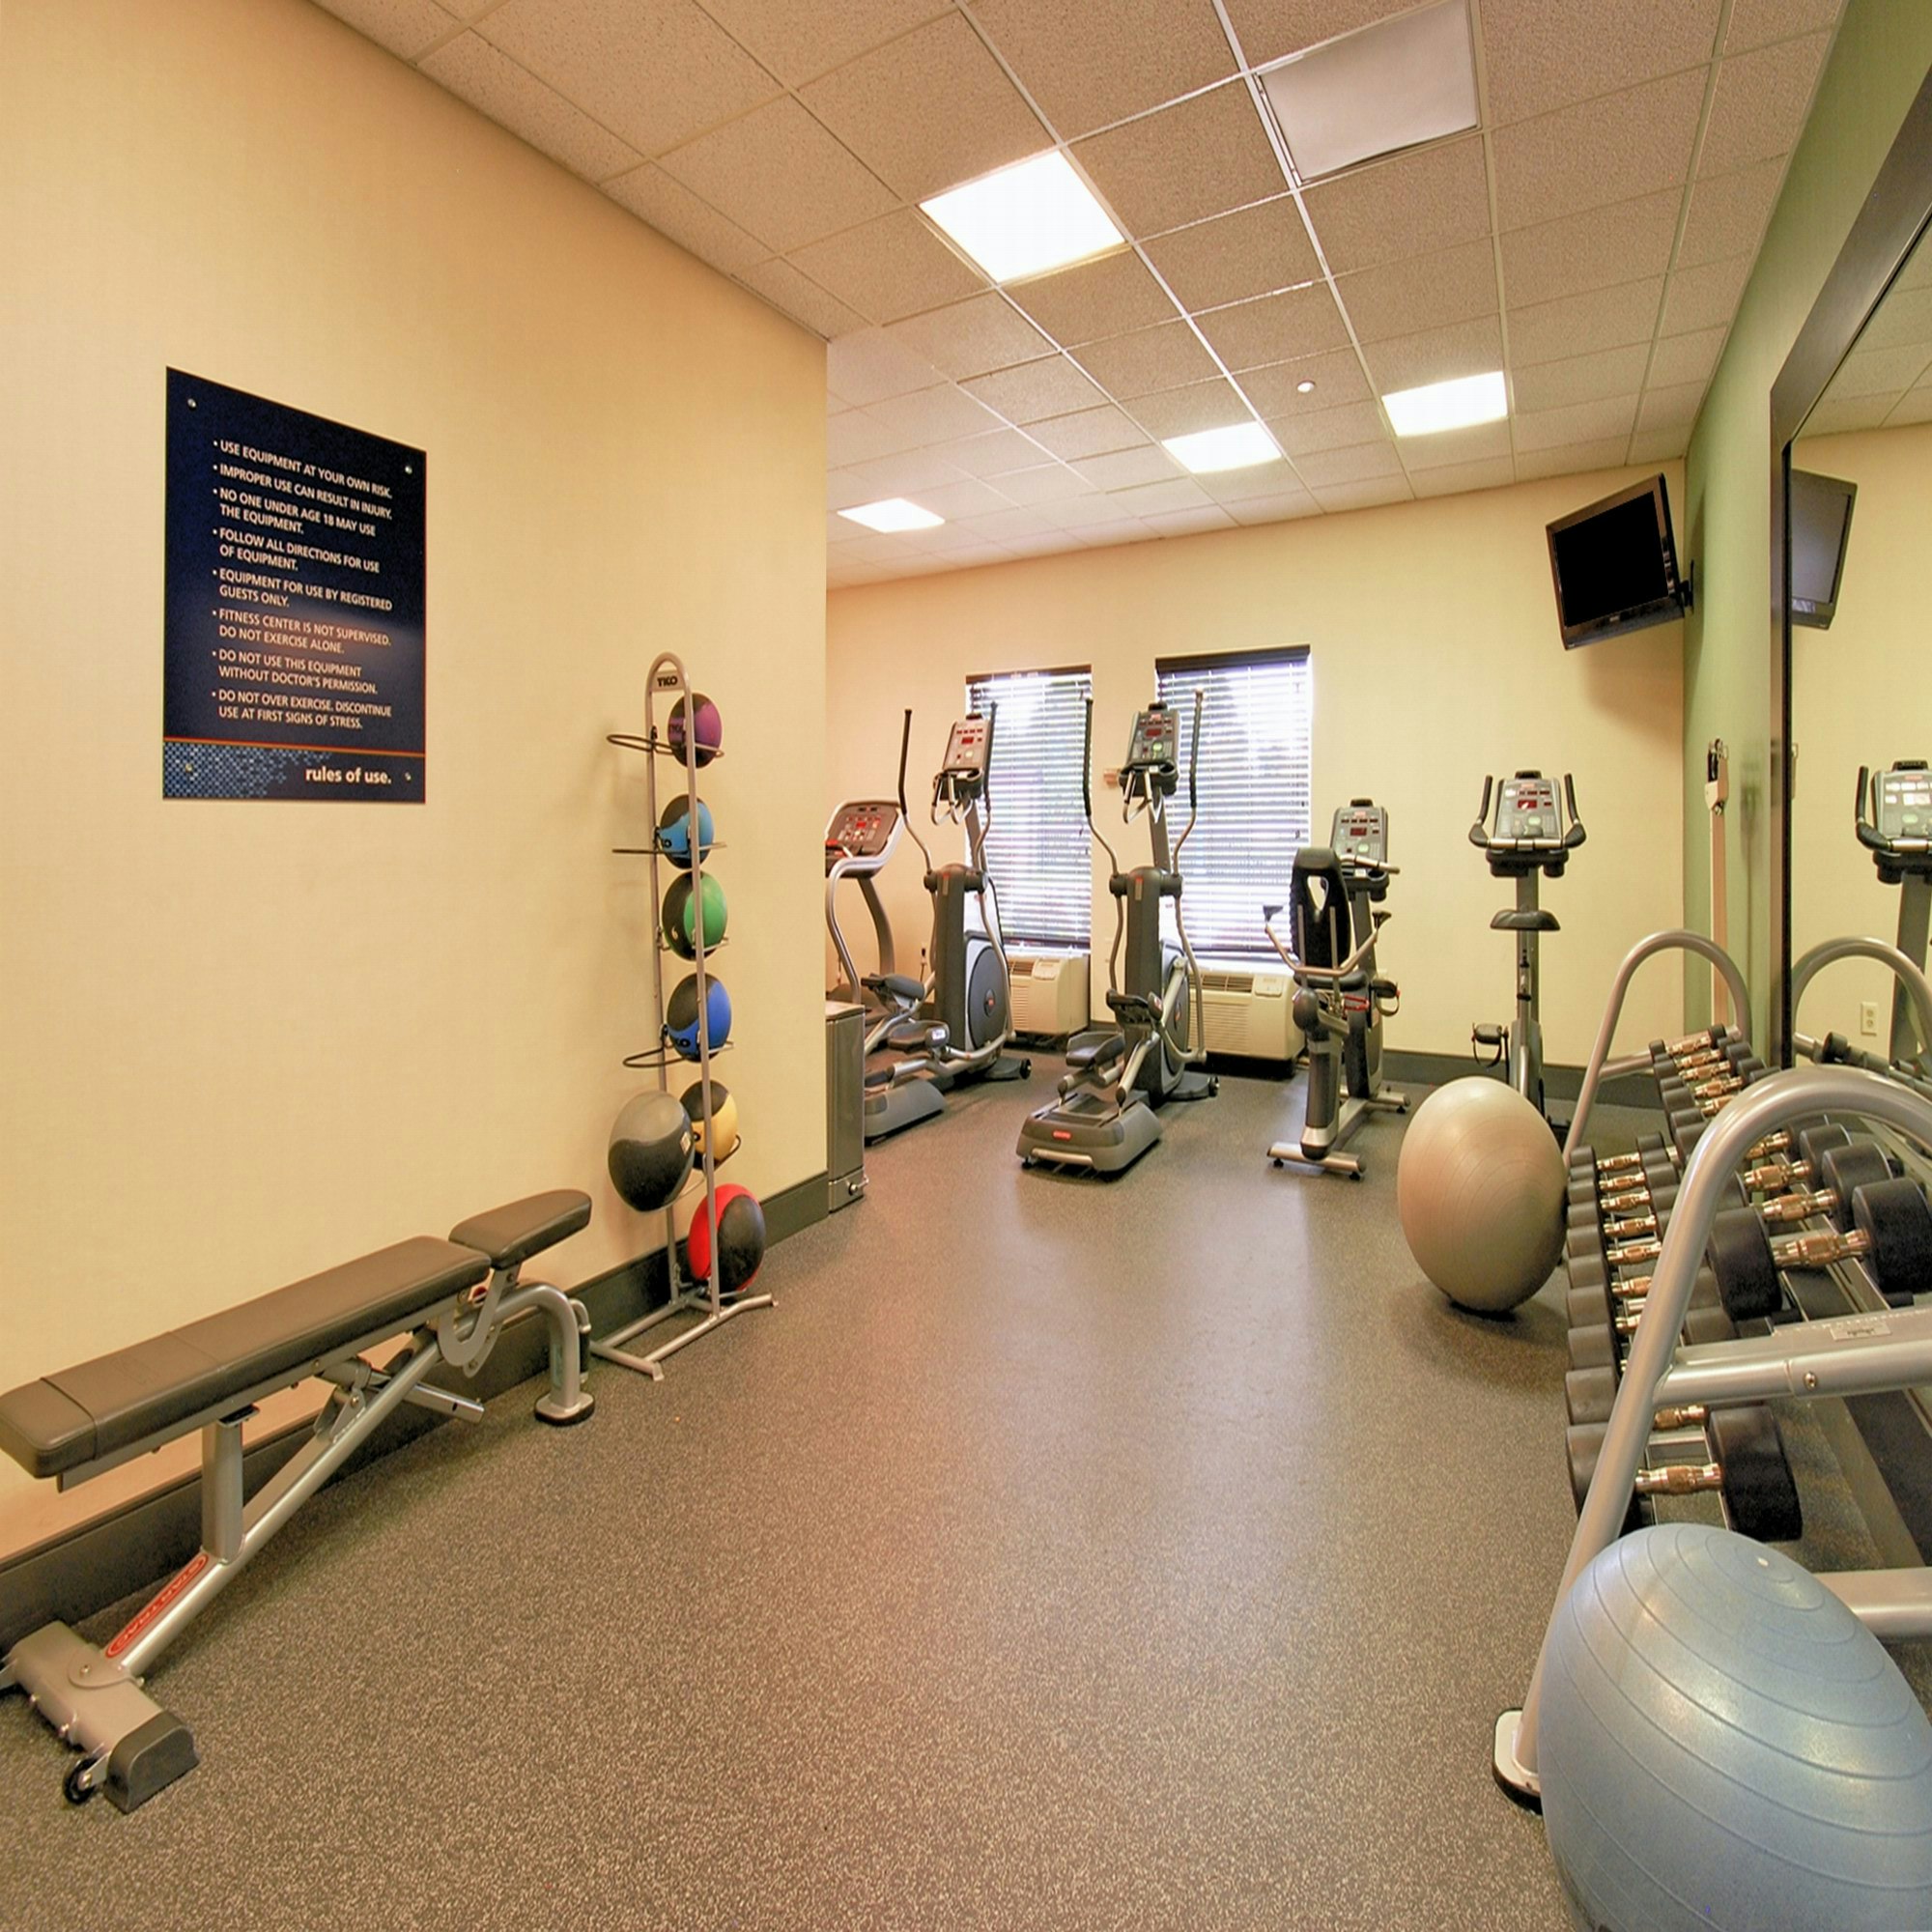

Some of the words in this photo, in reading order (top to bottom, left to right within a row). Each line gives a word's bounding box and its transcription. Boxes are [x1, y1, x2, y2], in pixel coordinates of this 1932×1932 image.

[220, 440, 240, 456] USE
[242, 446, 301, 472] EQUIPMENT
[303, 465, 316, 476] AT
[318, 468, 345, 486] YOUR
[347, 476, 370, 492] OWN
[371, 483, 392, 499] RISK.
[219, 464, 272, 488] IMPROPER
[273, 478, 293, 494] USE
[294, 483, 315, 498] CAN
[316, 490, 349, 508] RESULT
[350, 498, 360, 511] IN
[361, 501, 392, 521] INJURY.
[219, 503, 241, 520] THE
[243, 509, 304, 535] EQUIPMENT.
[220, 488, 238, 502] NO
[240, 492, 262, 508] ONE
[264, 498, 298, 517] UNDER
[300, 508, 321, 524] AGE
[324, 514, 334, 526] 18
[335, 517, 357, 531] MAY
[358, 523, 376, 537] USE
[219, 527, 265, 548] FOLLOW
[266, 539, 285, 553] ALL
[287, 542, 342, 565] DIRECTIONS
[343, 554, 361, 570] FOR
[362, 559, 380, 574] USE
[219, 544, 235, 557] OF
[237, 547, 298, 572] EQUIPMENT.
[219, 568, 281, 590] EQUIPMENT
[283, 580, 304, 595] FOR
[305, 584, 324, 599] USE
[325, 587, 339, 601] BY
[340, 590, 393, 611] REGISTERED
[219, 584, 259, 602] GUESTS
[261, 591, 290, 608] ONLY.
[219, 609, 260, 626] FITNESS
[262, 614, 301, 633] CENTER
[302, 621, 312, 635] IS
[314, 623, 334, 637] NOT
[336, 627, 392, 647] SUPERVISED.
[219, 625, 237, 638] DO
[239, 628, 262, 641] NOT
[264, 631, 308, 650] EXERCISE
[310, 639, 345, 654] ALONE.
[219, 648, 237, 663] DO
[239, 651, 262, 665] NOT
[263, 655, 282, 668] USE
[285, 657, 306, 671] THIS
[307, 660, 362, 677] EQUIPMENT
[218, 665, 270, 682] WITHOUT
[271, 671, 321, 689] DOCTOR'S
[322, 677, 378, 695] PERMISSION.
[218, 689, 236, 702] DO
[238, 691, 261, 705] NOT
[262, 694, 289, 708] OVER
[335, 700, 392, 718] DISCONTINUE
[218, 706, 240, 719] USE
[241, 707, 255, 721] AT
[257, 709, 283, 723] FIRST
[285, 711, 313, 725] SIGNS
[315, 713, 328, 726] OF
[329, 715, 363, 729] STRESS.
[305, 765, 342, 782] rules
[345, 766, 361, 783] of
[364, 770, 392, 784] use.
